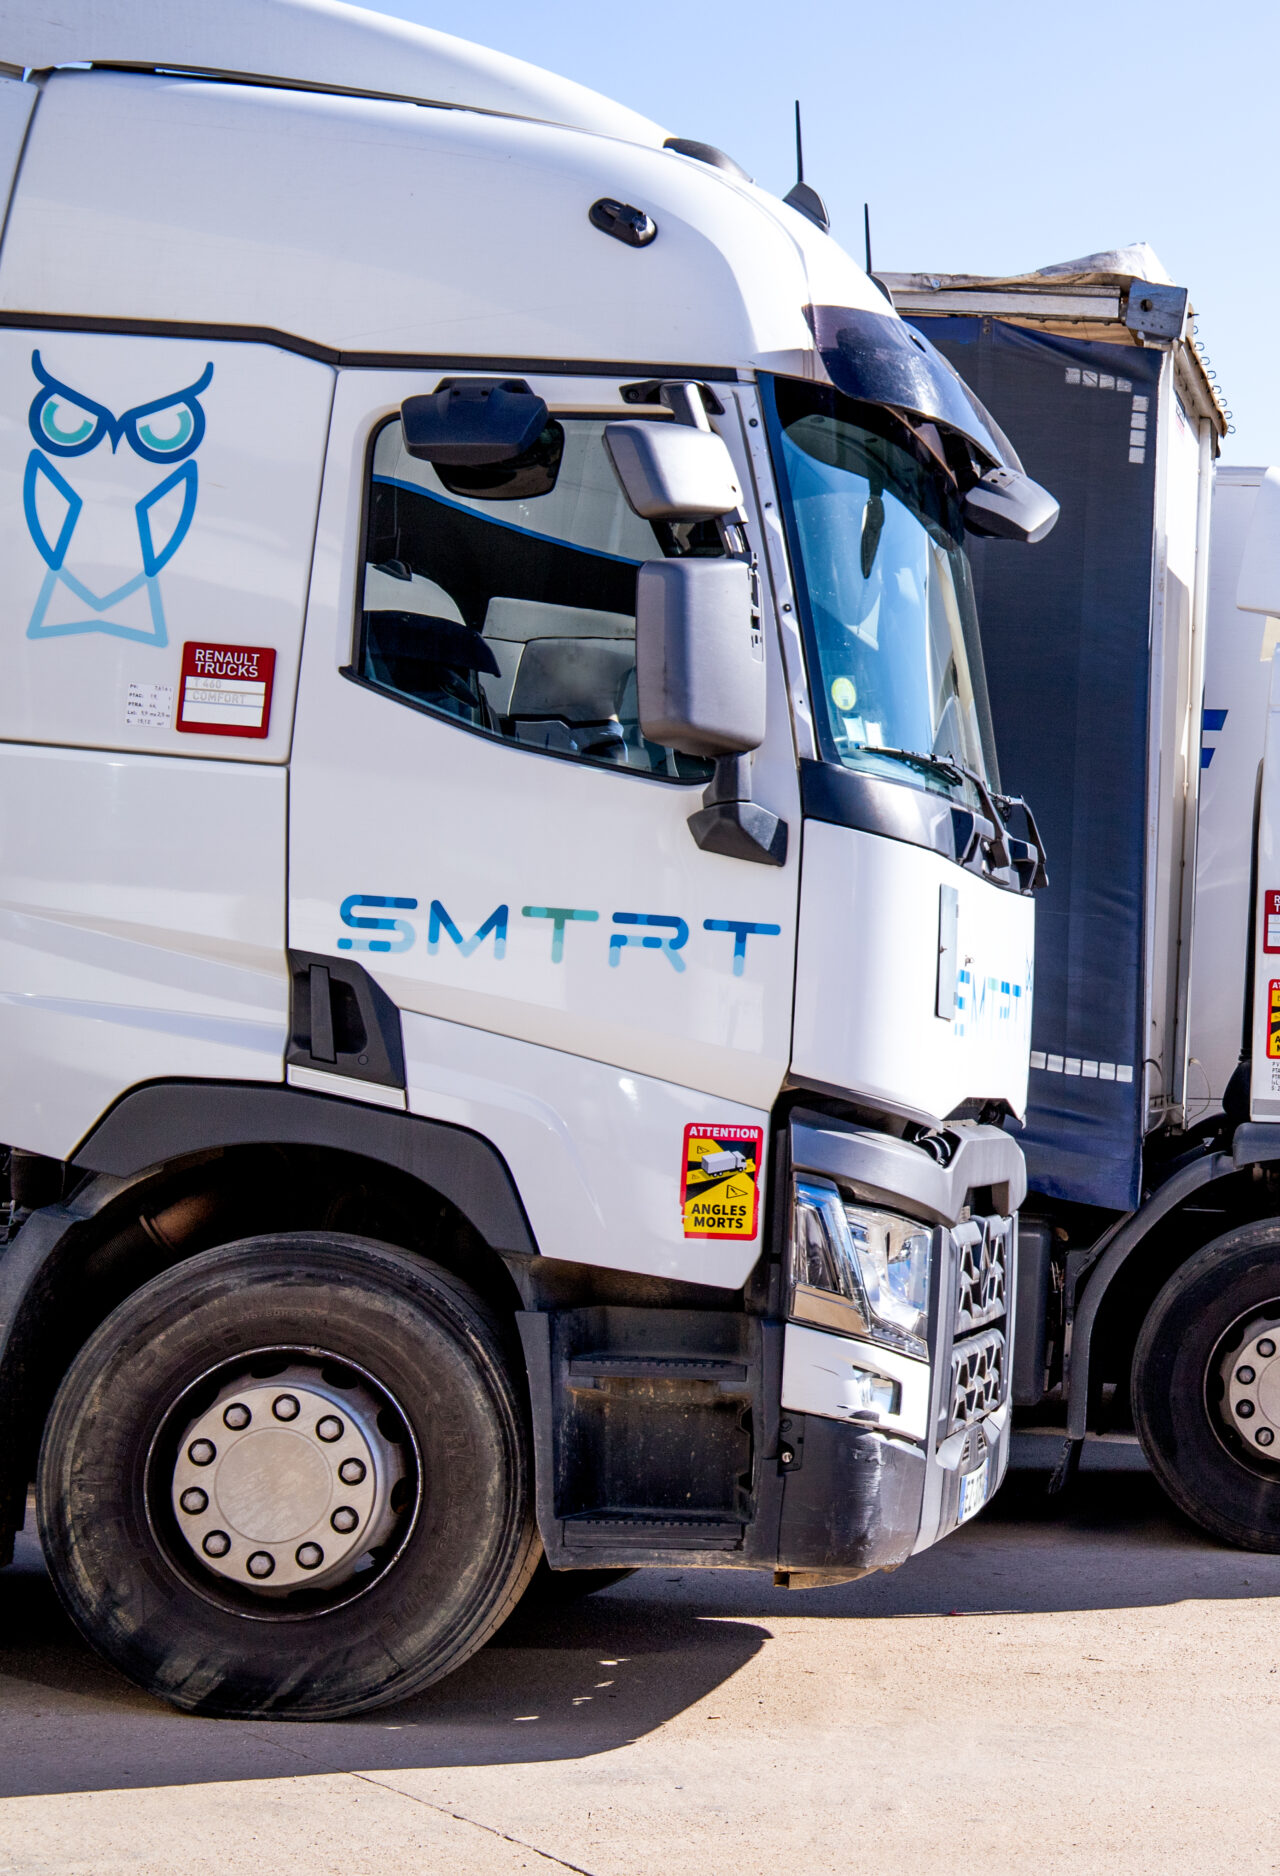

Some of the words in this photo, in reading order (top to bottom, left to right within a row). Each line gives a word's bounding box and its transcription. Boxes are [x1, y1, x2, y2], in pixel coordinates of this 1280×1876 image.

[195, 648, 260, 666] RENAULT
[195, 660, 258, 678] TRUCKS
[192, 691, 246, 704] COMFORT
[337, 894, 781, 977] SMTRT
[689, 1126, 759, 1139] ATTENTION
[691, 1203, 747, 1217] ANGLES
[693, 1216, 744, 1229] MORTS
